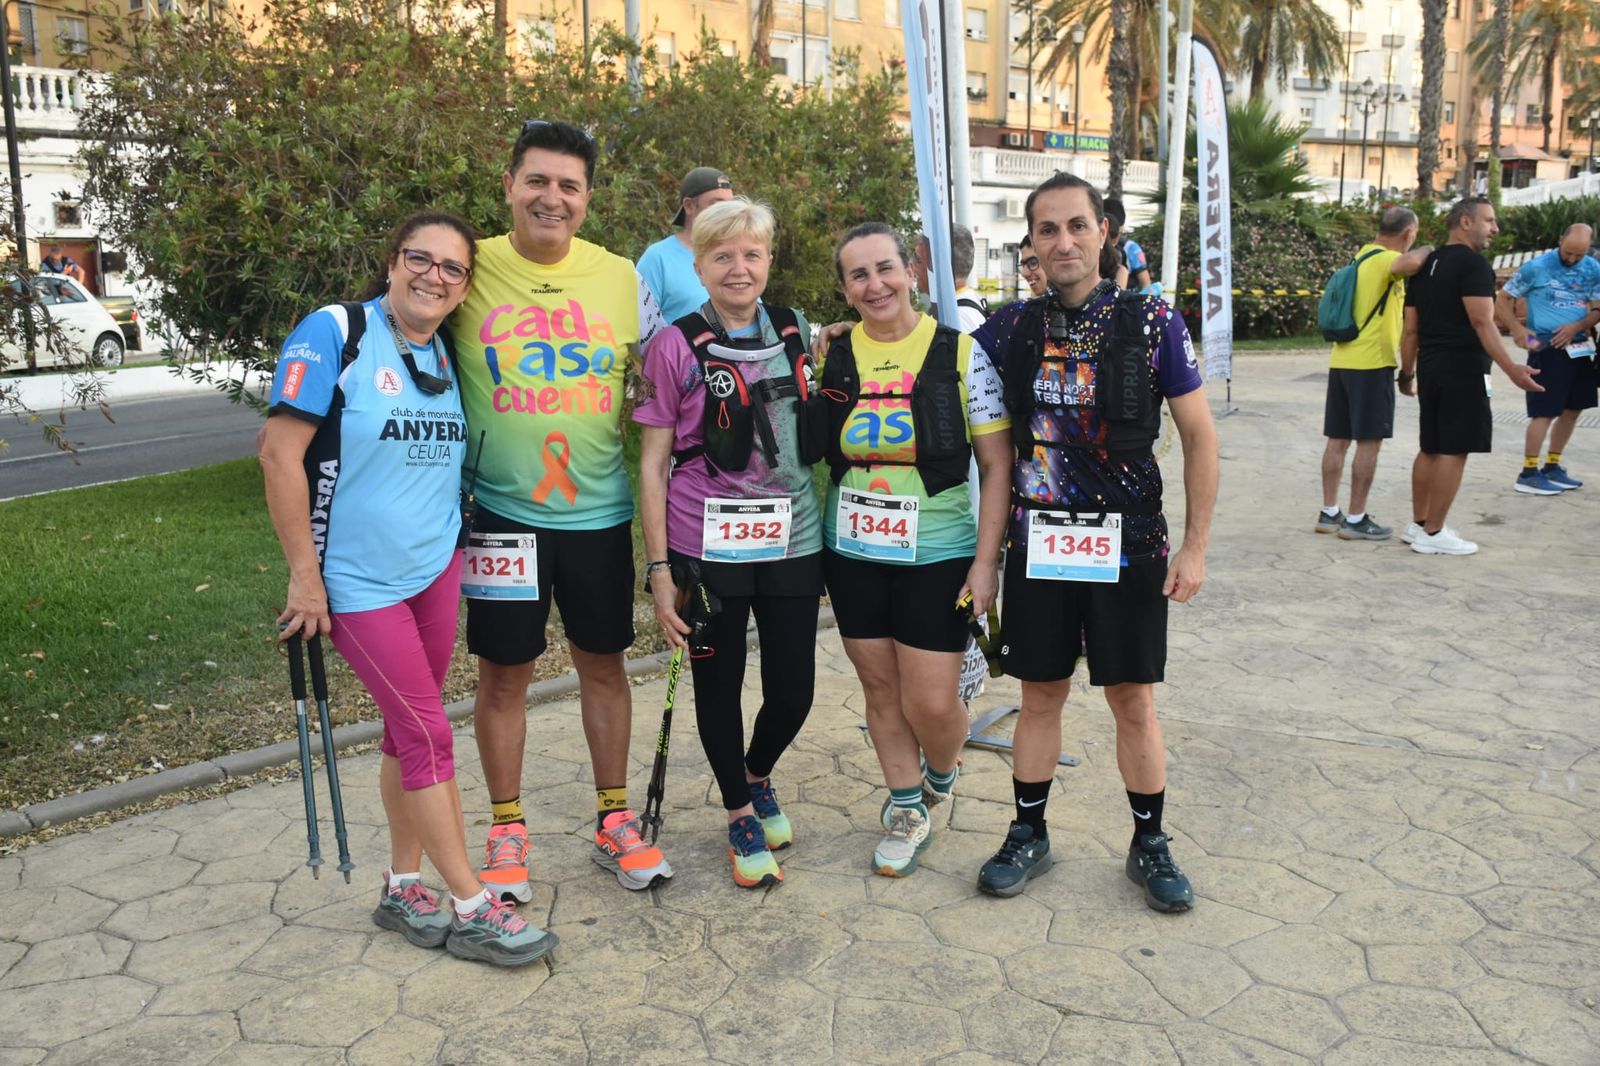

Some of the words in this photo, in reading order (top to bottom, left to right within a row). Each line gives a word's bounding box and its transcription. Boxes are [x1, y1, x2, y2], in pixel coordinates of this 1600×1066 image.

[1063, 135, 1110, 150] FAMACIA
[1122, 346, 1140, 419] KIPRUN
[391, 407, 413, 417] club
[938, 382, 954, 450] KIPRUN
[379, 419, 468, 442] ANYERA
[407, 444, 451, 460] CEUTA
[719, 521, 782, 540] 1352
[848, 511, 908, 537] 1344
[1043, 534, 1111, 556] 1345
[468, 555, 525, 576] 1321
[666, 659, 680, 704] FIZAN
